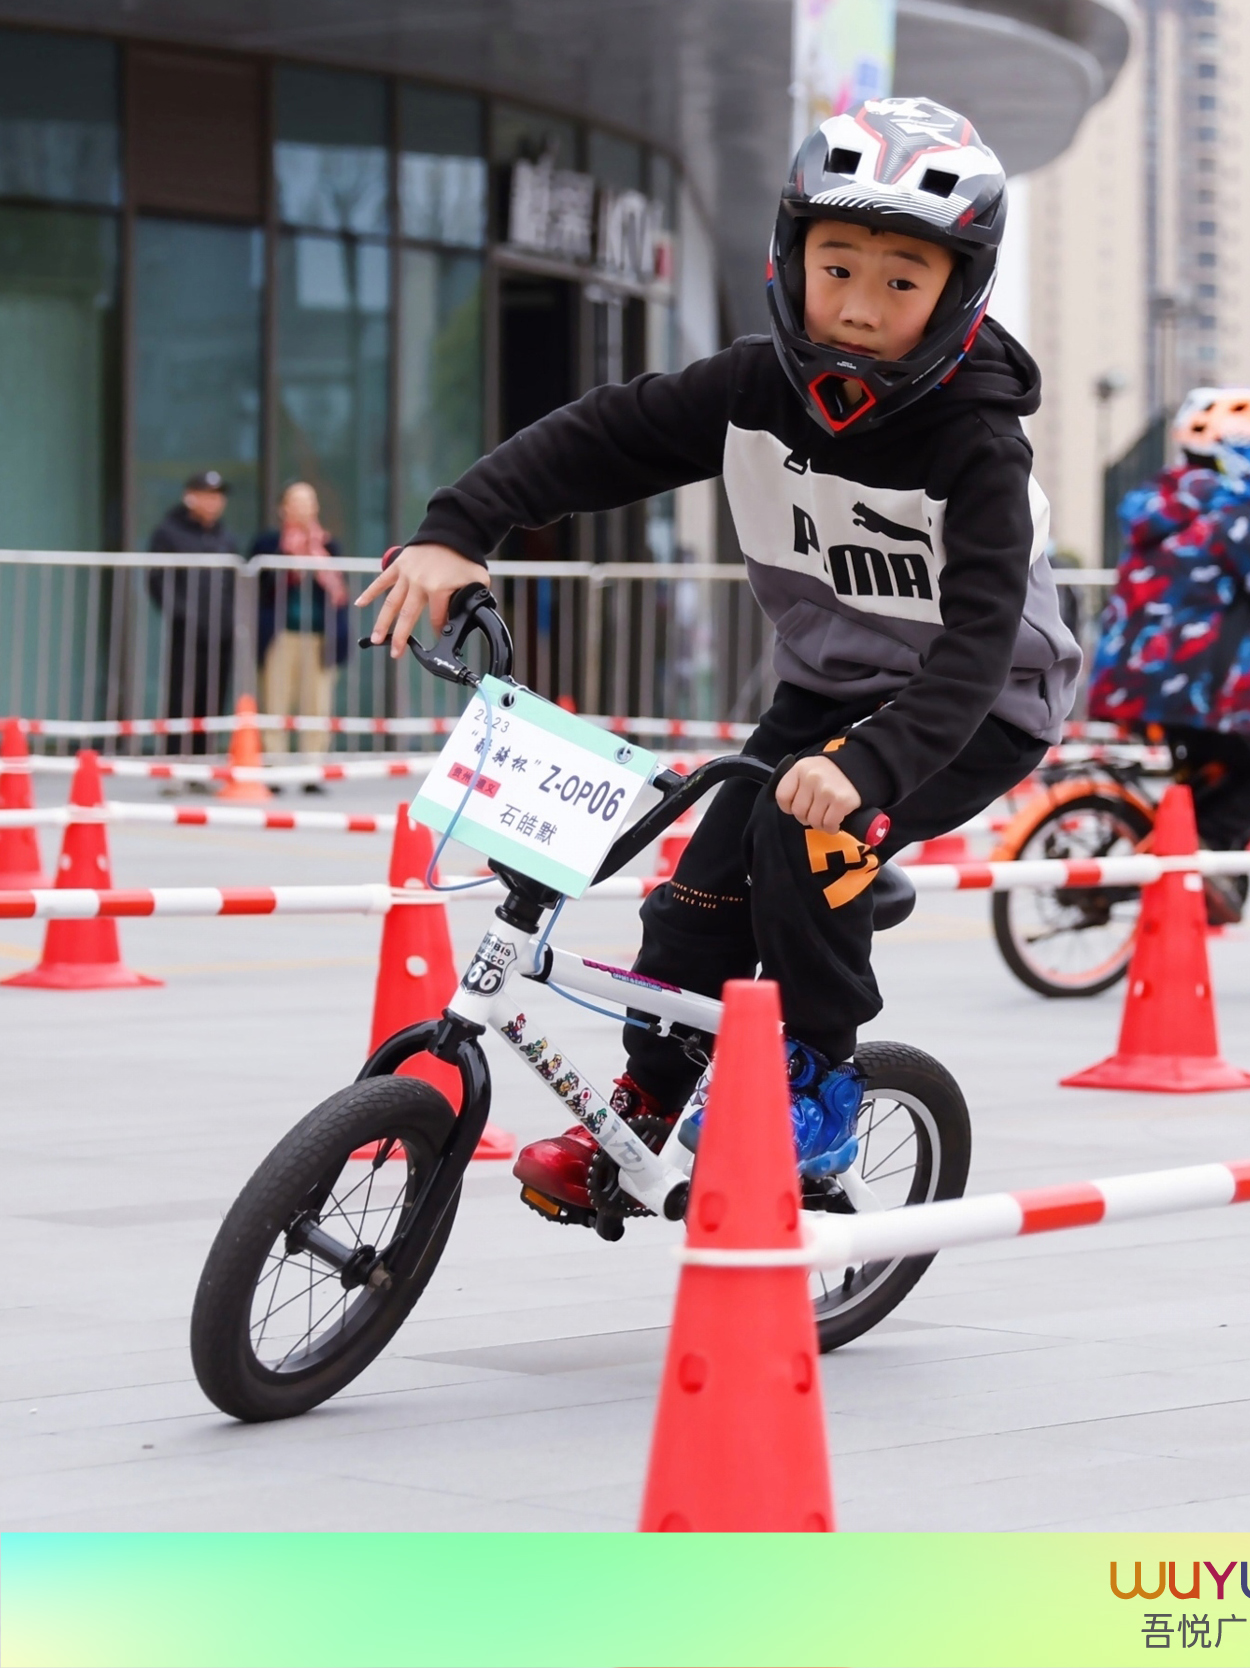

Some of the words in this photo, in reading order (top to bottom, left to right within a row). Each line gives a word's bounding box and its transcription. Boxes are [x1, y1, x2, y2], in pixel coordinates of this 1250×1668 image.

[792, 503, 934, 601] PMA
[538, 764, 626, 822] Z-OP06
[466, 956, 502, 991] 66
